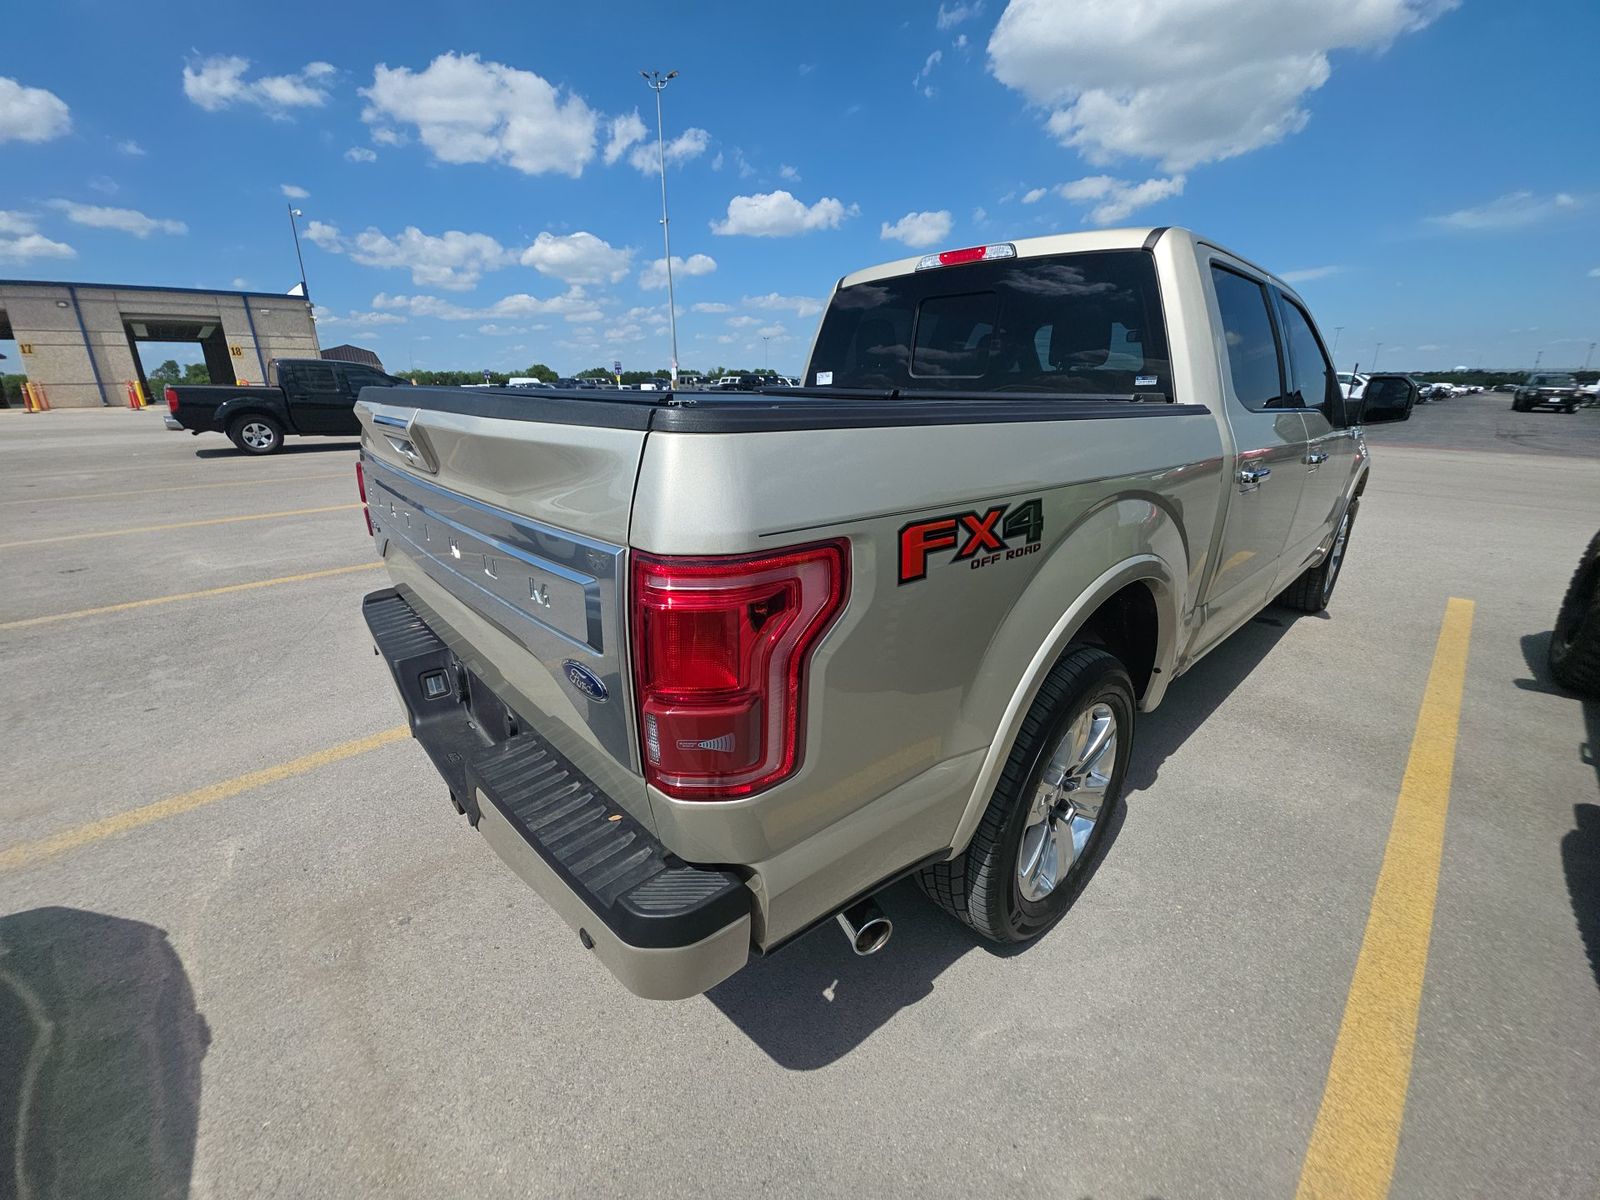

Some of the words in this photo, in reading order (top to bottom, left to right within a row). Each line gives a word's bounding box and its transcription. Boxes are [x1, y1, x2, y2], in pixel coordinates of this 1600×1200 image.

[20, 343, 33, 354] 17
[231, 346, 242, 356] 18
[897, 498, 1044, 587] FX4
[970, 554, 1001, 570] OFF
[1005, 542, 1042, 561] ROAD
[568, 668, 594, 696] Ford
